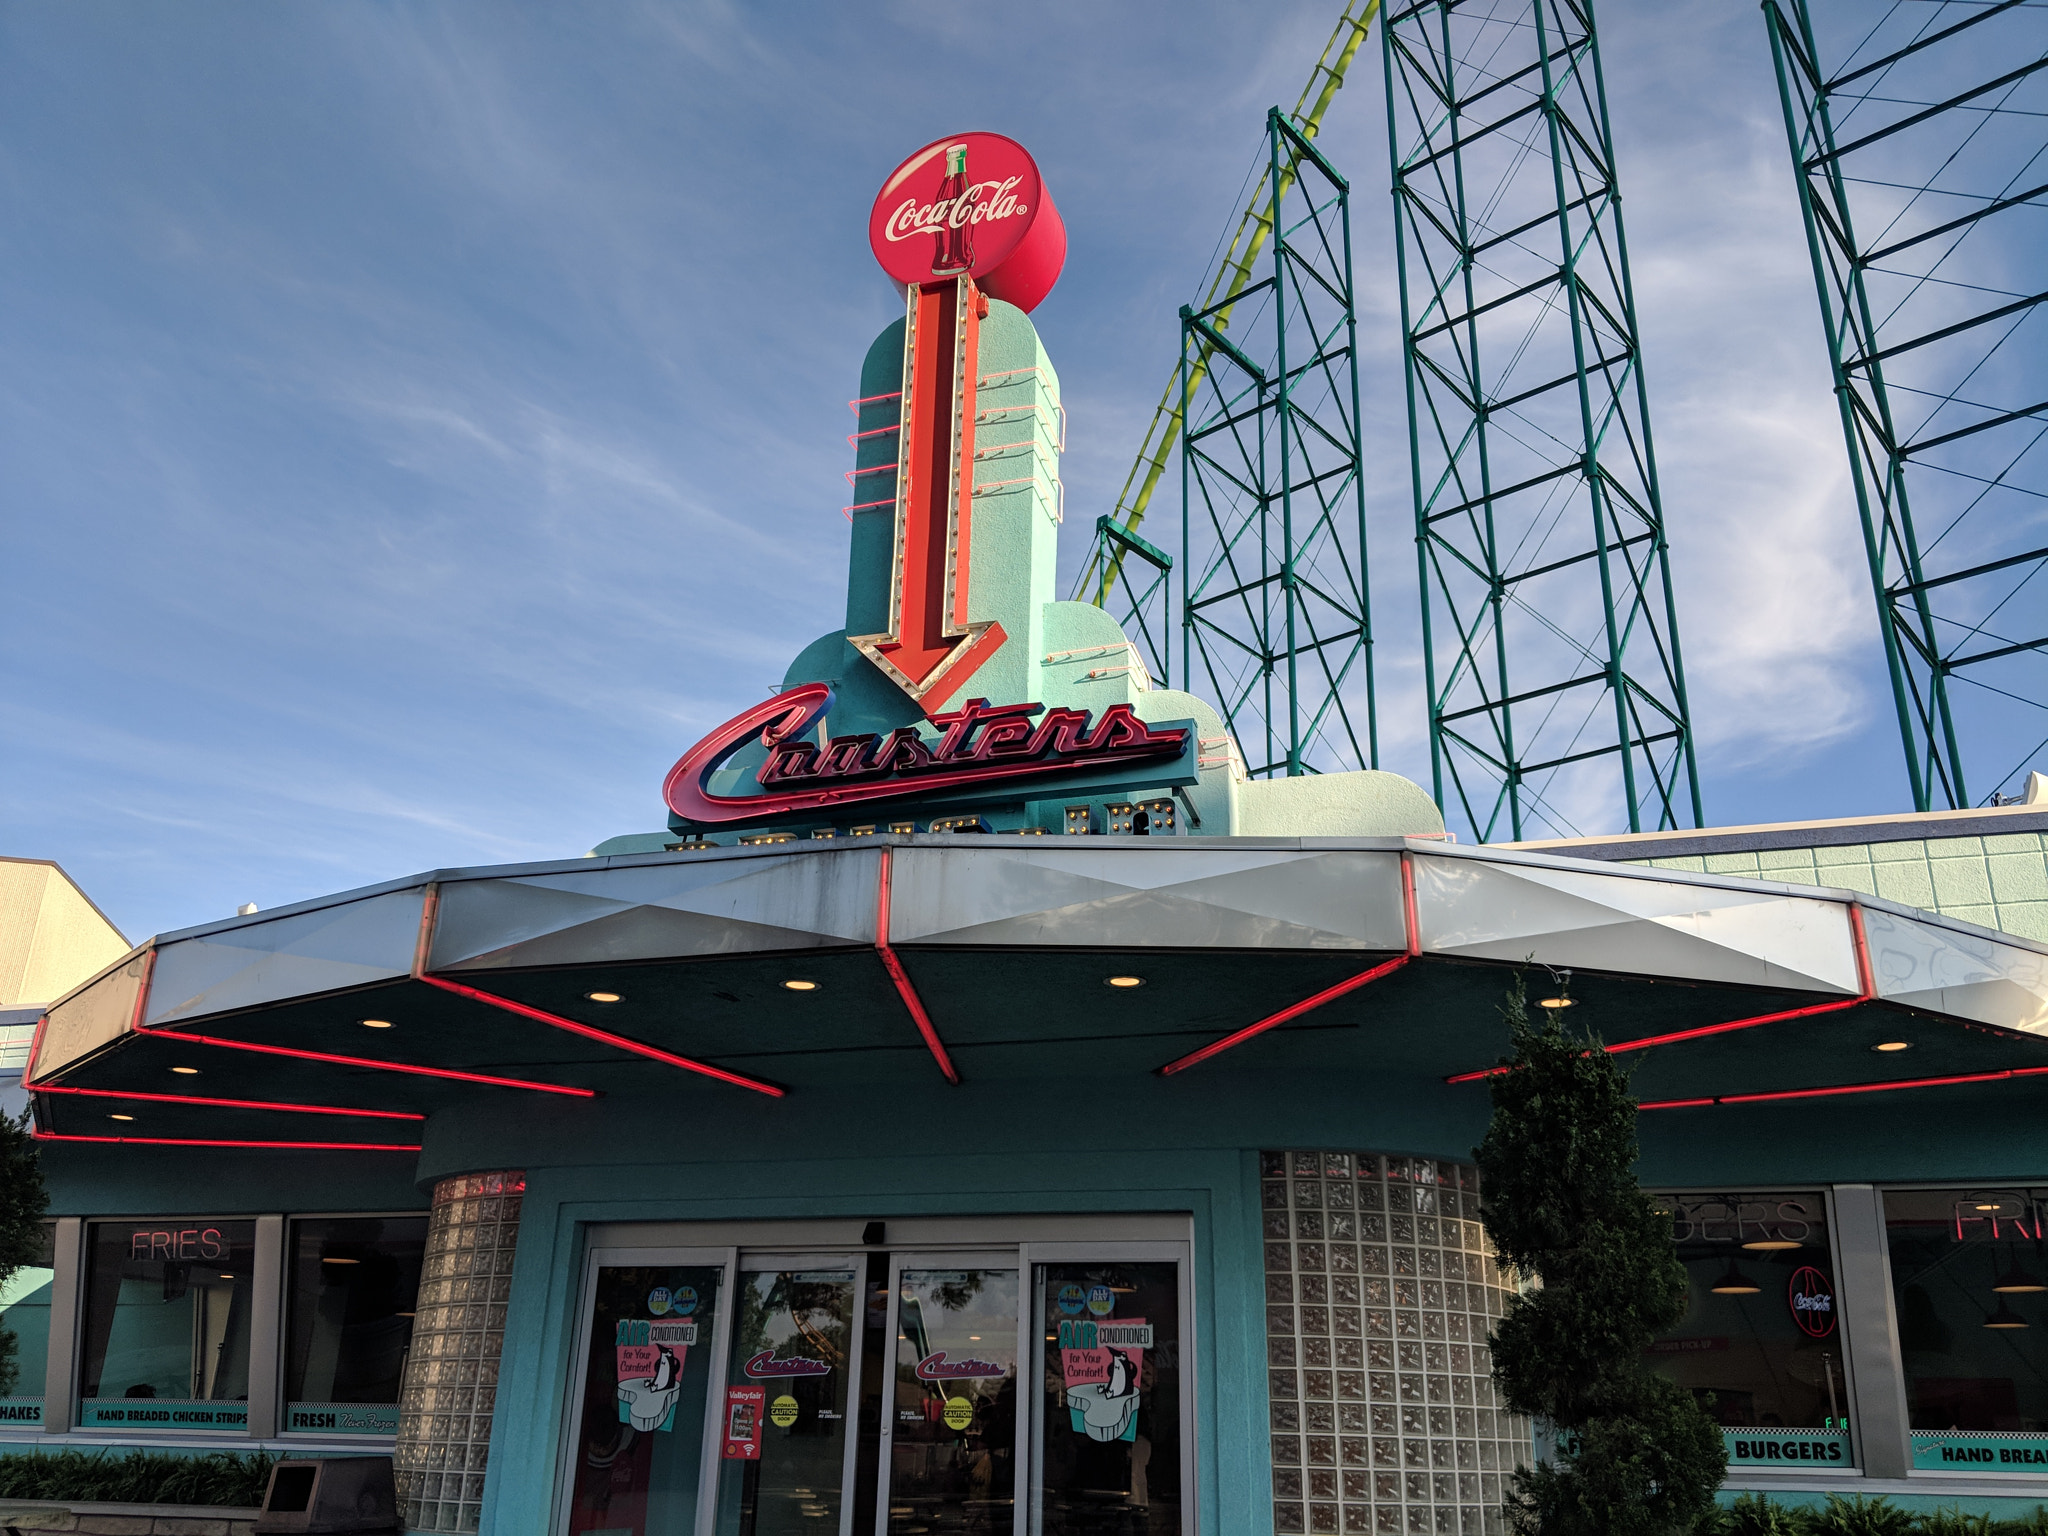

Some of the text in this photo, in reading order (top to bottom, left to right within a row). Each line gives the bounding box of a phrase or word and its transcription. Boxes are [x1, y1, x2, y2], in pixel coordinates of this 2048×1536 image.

[885, 174, 1024, 241] Coca-Cola
[662, 682, 1190, 822] Coasters
[1668, 1200, 1810, 1242] GERS
[1955, 1199, 2043, 1241] FRI
[131, 1228, 222, 1261] FRIES
[616, 1319, 694, 1346] AIR CONDITIONED
[1058, 1320, 1149, 1349] AIR CONDITIONED
[620, 1361, 652, 1373] Comfort!
[623, 1349, 651, 1360] for Your
[744, 1350, 832, 1378] Coasters
[915, 1351, 1006, 1380] Coasters
[1069, 1352, 1101, 1363] for Your
[1067, 1366, 1103, 1378] Comfort!
[729, 1390, 762, 1400] Valleyfair
[0, 1406, 41, 1420] HAKES
[97, 1410, 248, 1425] HAND BREADED CHICKEN STRIPS
[293, 1412, 397, 1432] FRESH Never Frozen
[1735, 1440, 1841, 1460] BURGERS
[1915, 1439, 2048, 1464] Signature HAND BREA
